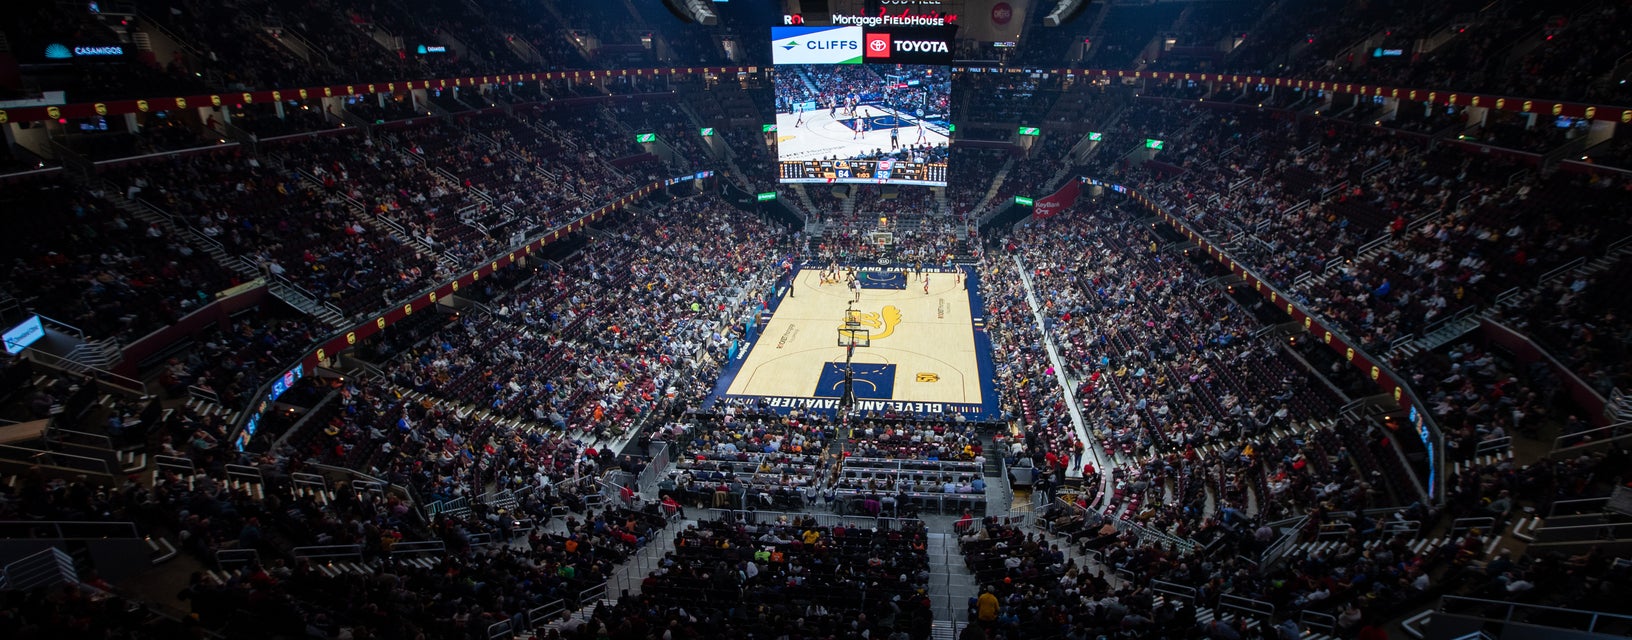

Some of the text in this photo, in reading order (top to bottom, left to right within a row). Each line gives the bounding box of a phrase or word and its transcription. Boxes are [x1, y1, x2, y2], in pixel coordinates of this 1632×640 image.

[832, 14, 882, 26] Mortgage
[807, 40, 858, 50] CLIFFS
[894, 40, 949, 53] TOYOTA
[74, 46, 123, 55] CASAMIGOS
[877, 171, 889, 179] 52
[1035, 201, 1060, 209] KeyBank
